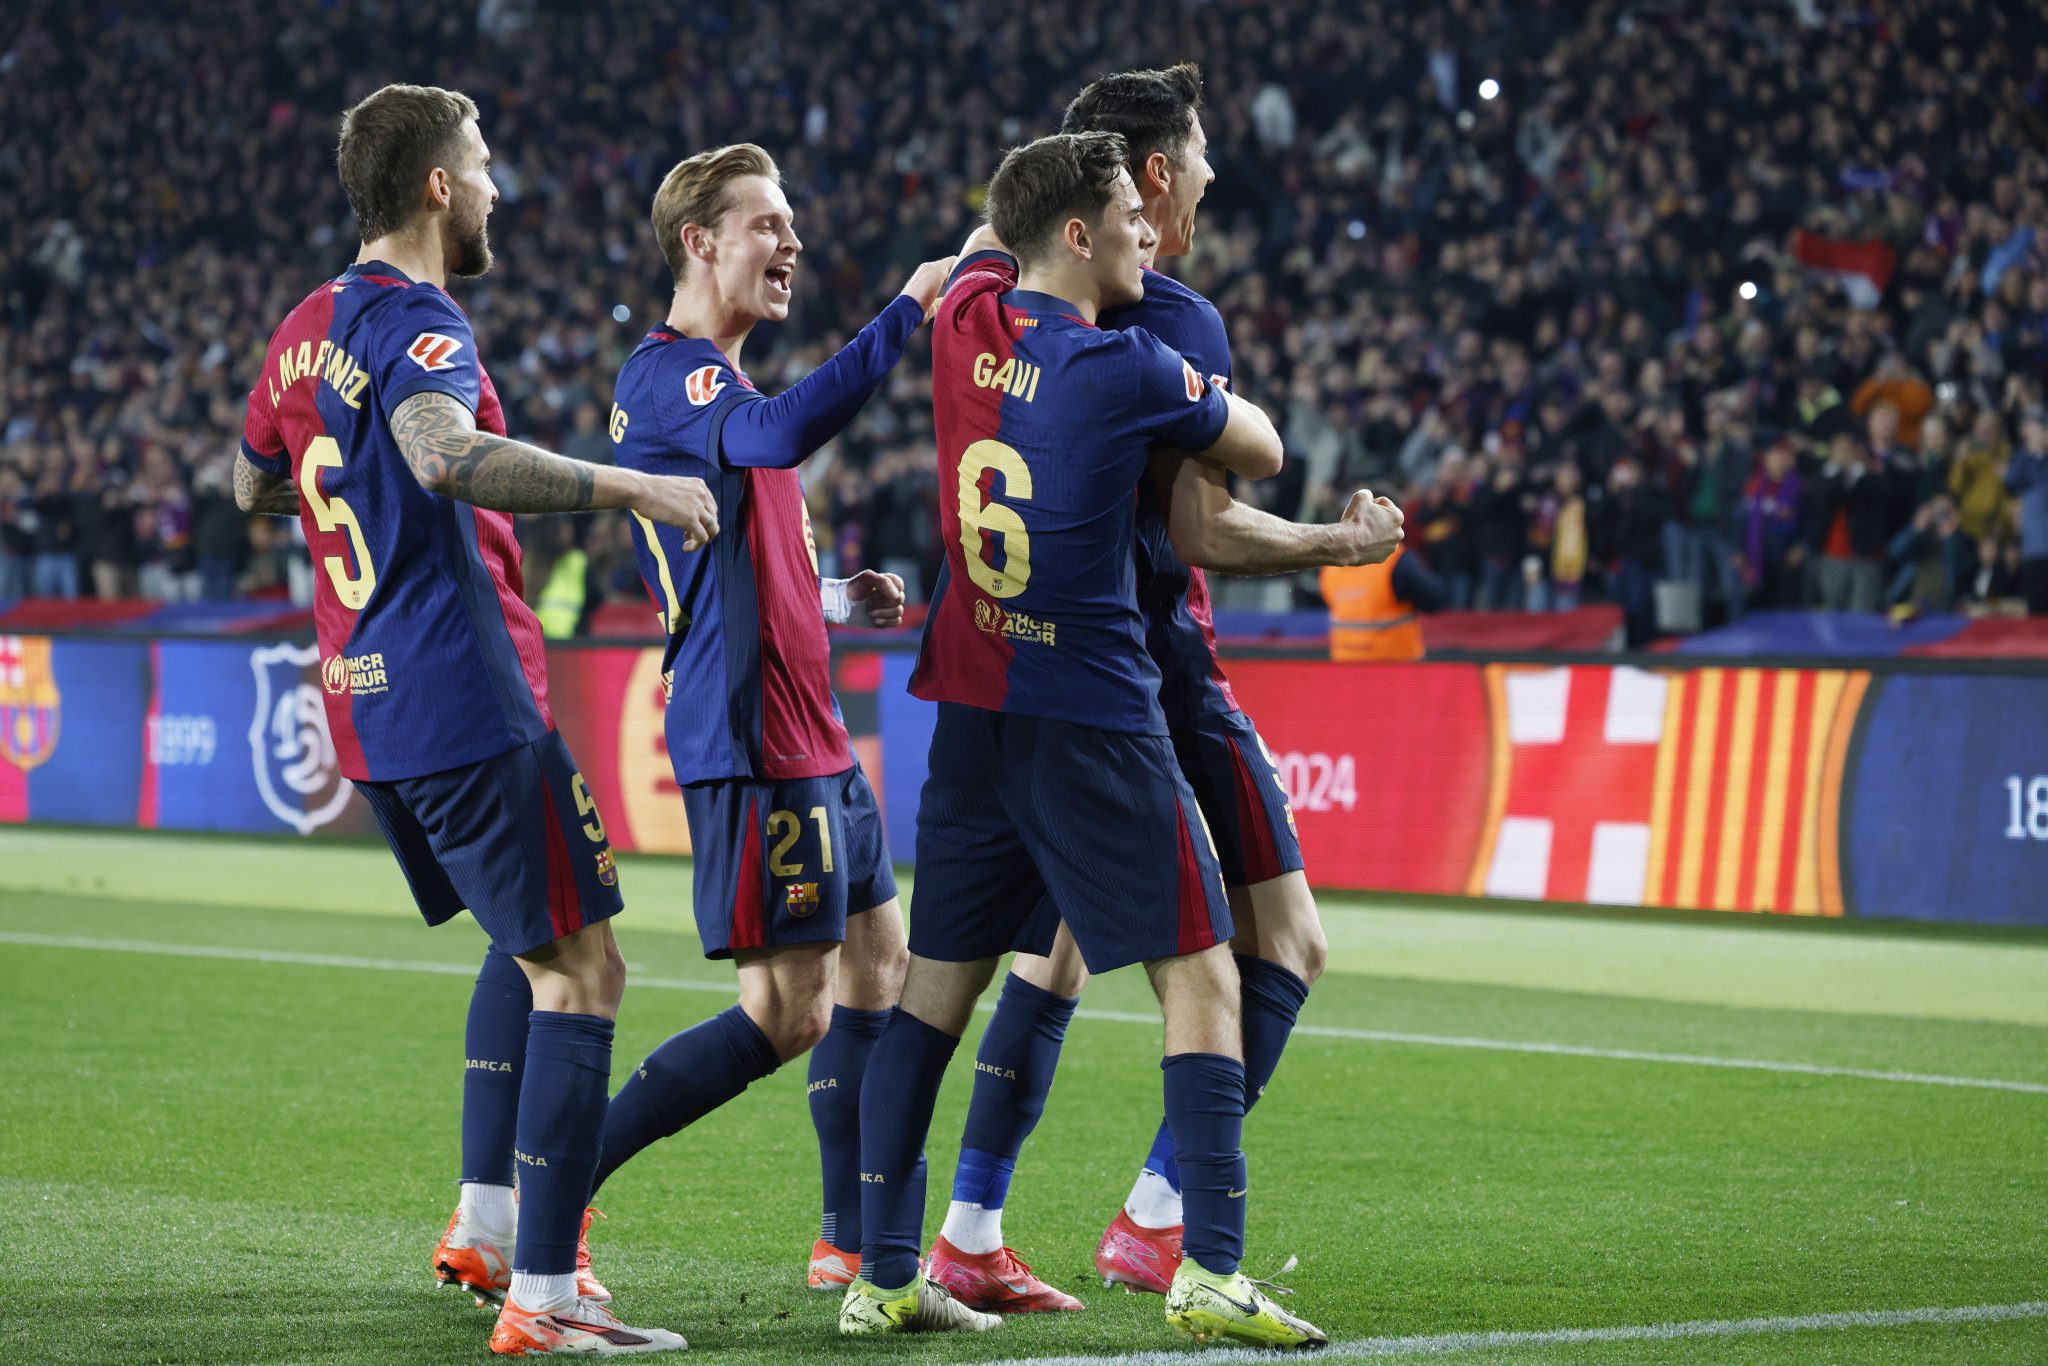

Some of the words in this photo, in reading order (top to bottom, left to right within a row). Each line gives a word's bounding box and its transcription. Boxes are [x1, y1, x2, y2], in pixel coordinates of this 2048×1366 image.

[280, 340, 370, 410] MARINEZ
[974, 353, 1041, 403] GAVI
[300, 435, 377, 610] 5
[957, 439, 1033, 598] 6
[1001, 619, 1056, 646] ACR
[350, 669, 388, 688] AUR
[571, 771, 606, 843] 5
[766, 806, 834, 877] 21
[514, 1148, 548, 1167] ARÇA
[860, 1172, 885, 1184] RÇA
